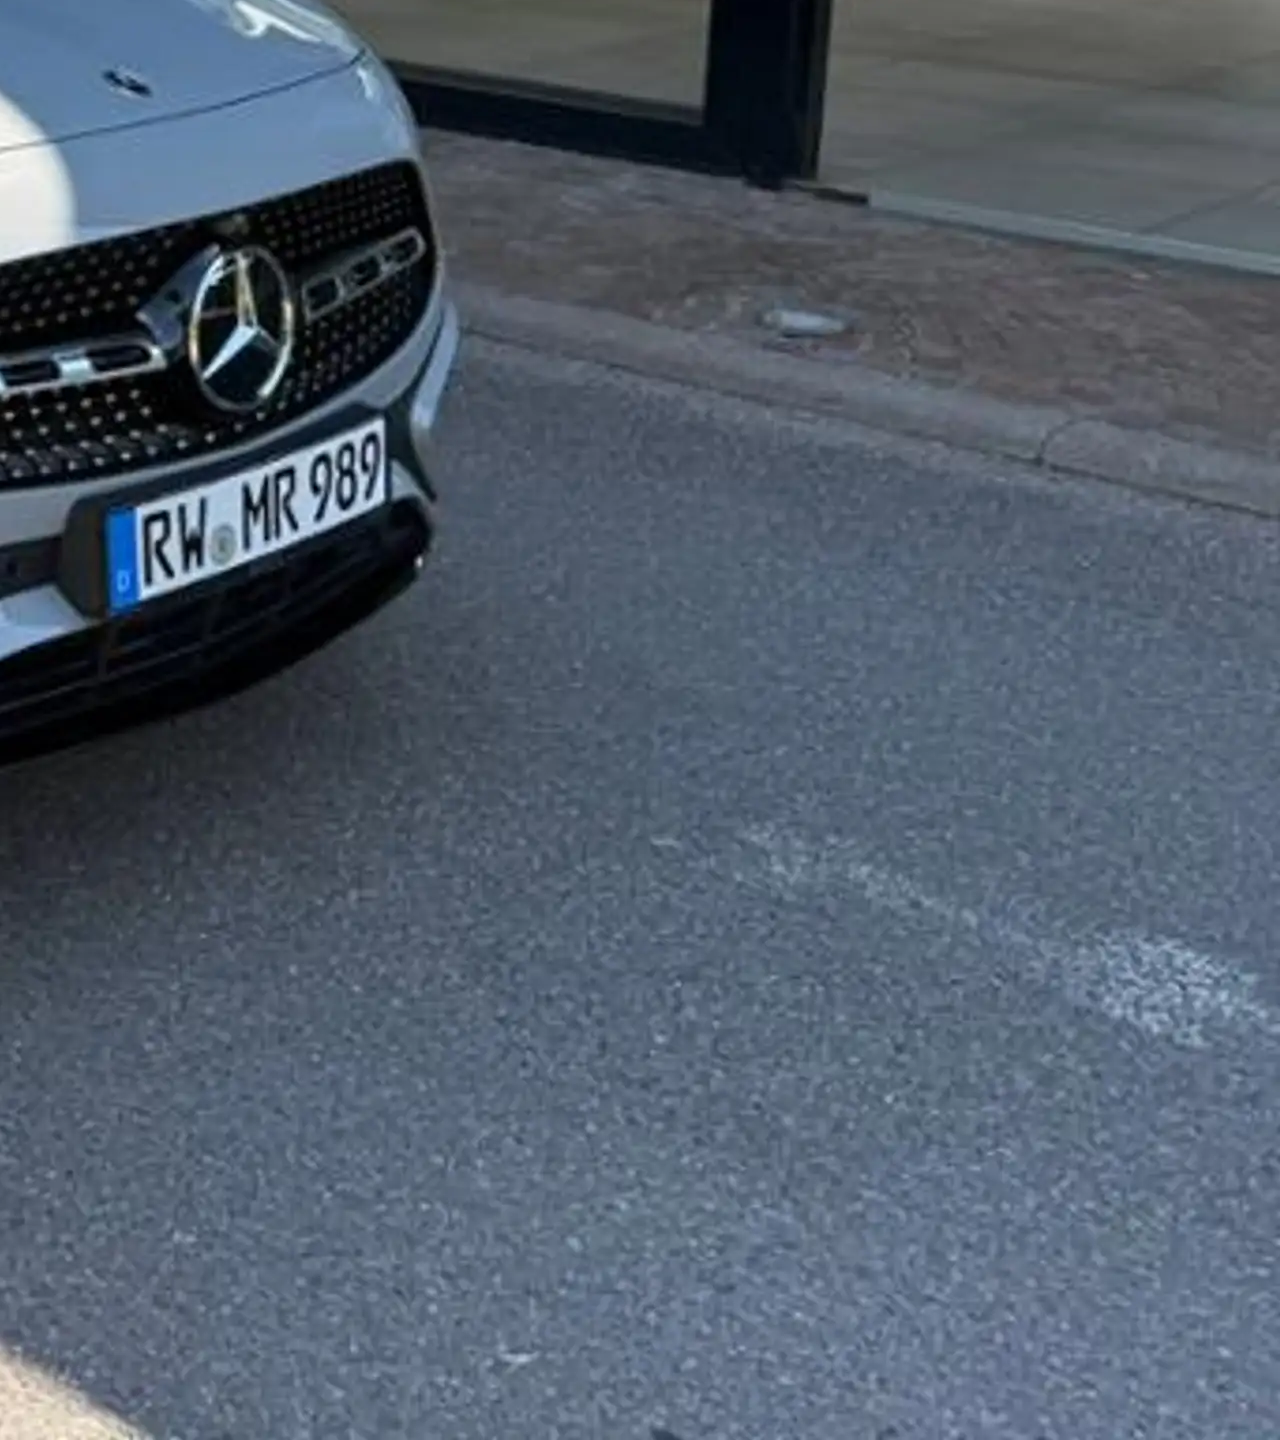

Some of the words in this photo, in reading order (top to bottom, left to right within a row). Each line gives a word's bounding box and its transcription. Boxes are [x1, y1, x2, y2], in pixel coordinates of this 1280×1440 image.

[142, 497, 207, 586] RW
[242, 466, 299, 551] MR
[309, 431, 381, 523] 989
